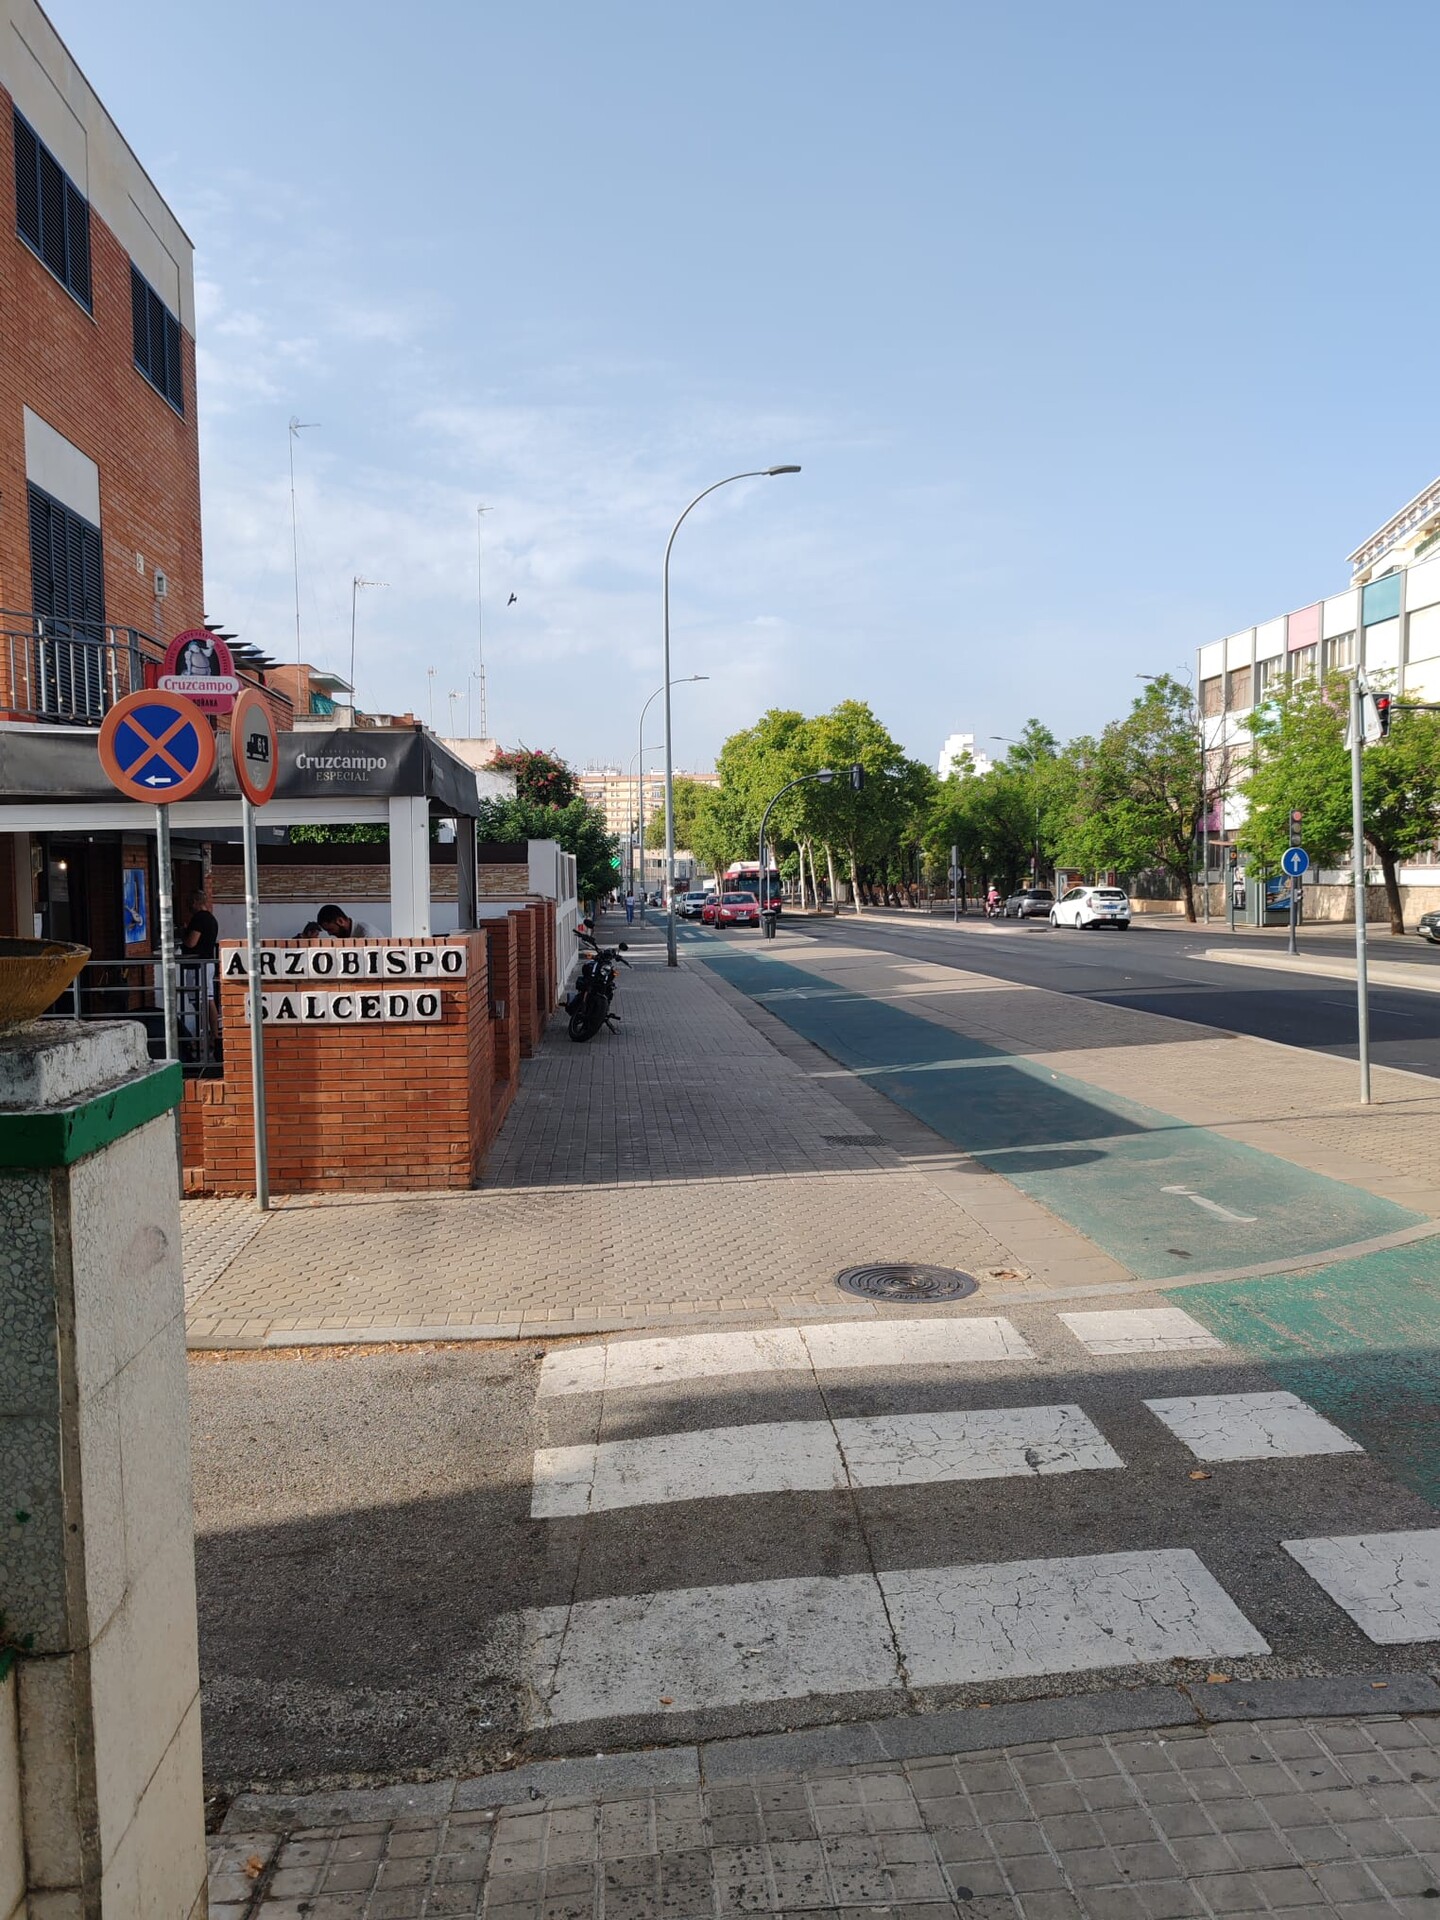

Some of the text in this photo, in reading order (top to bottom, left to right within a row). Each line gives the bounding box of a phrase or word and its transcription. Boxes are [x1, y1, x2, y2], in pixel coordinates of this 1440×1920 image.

[164, 678, 233, 692] Cruzcampo
[295, 752, 387, 772] Cruzcampo
[316, 771, 369, 782] ESPECIAL
[226, 950, 463, 975] ARZOBISPO
